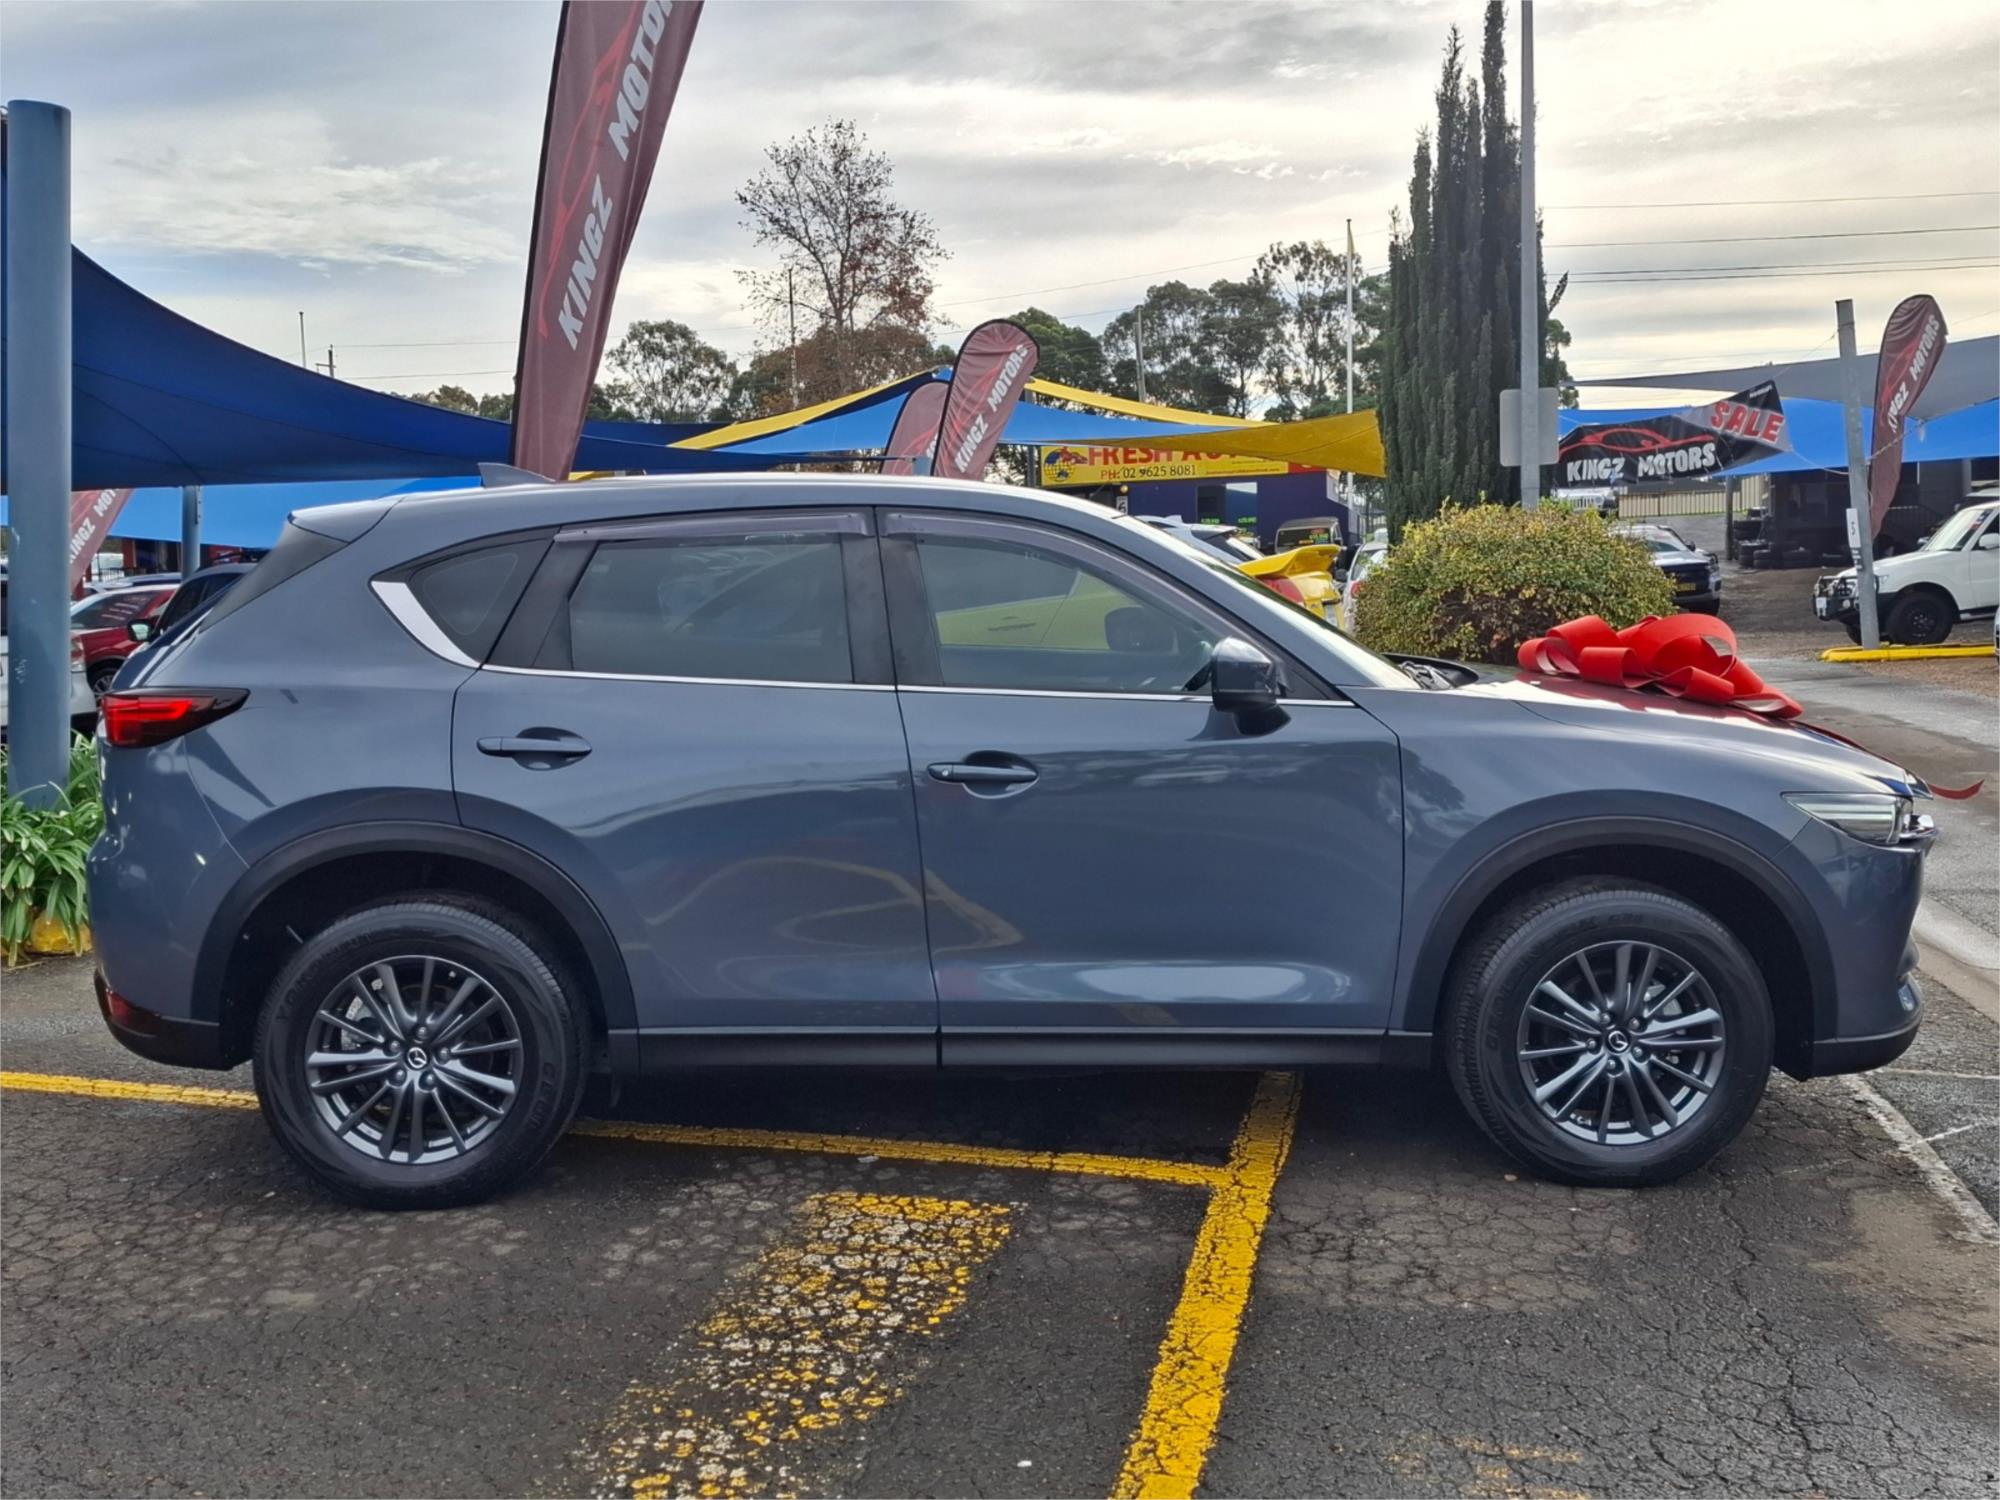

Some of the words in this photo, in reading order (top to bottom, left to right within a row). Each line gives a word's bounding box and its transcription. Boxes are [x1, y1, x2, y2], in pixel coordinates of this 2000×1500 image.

[558, 174, 612, 350] KINGZ
[1909, 314, 1940, 381] MOTORS
[954, 413, 988, 473] KINGZ
[987, 344, 1028, 412] MOTORS
[1710, 400, 1784, 444] SALE
[1122, 467, 1136, 478] 02
[1169, 465, 1196, 476] 8081
[1566, 457, 1626, 482] KINGZ
[1637, 442, 1716, 477] MOTORS
